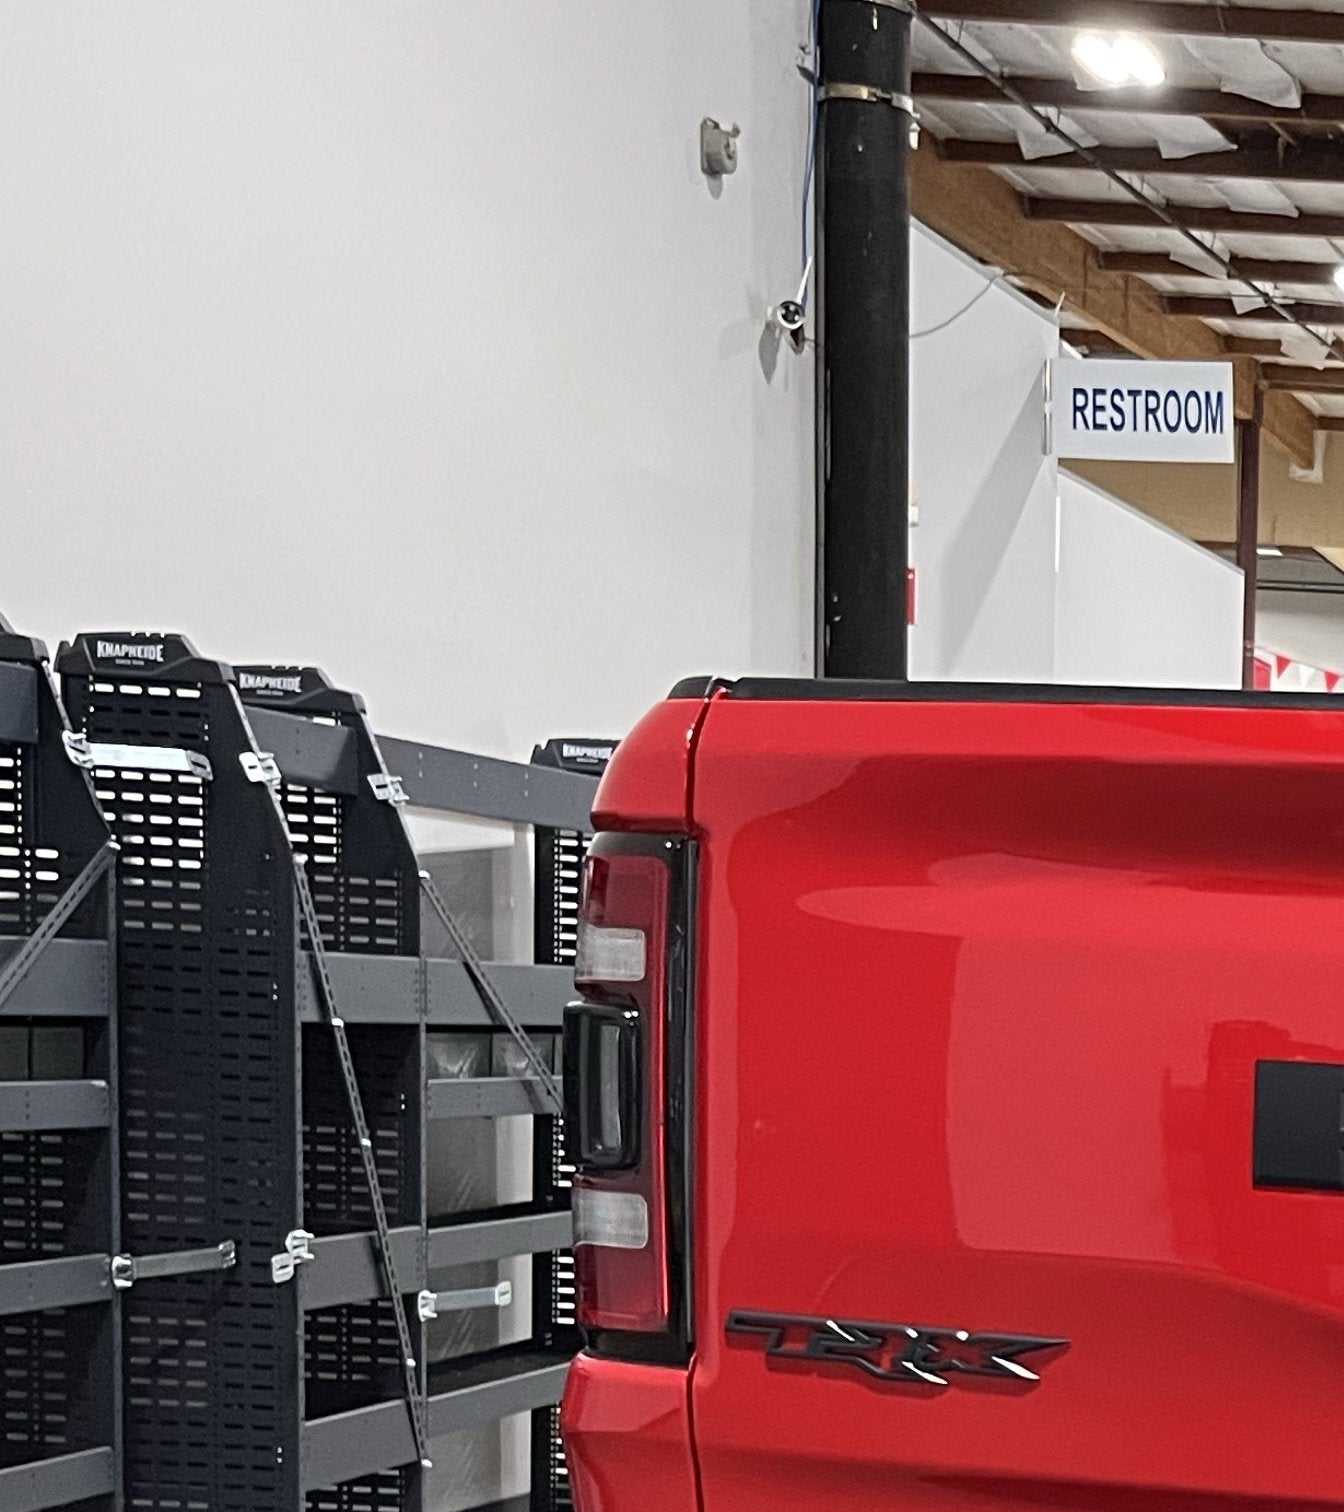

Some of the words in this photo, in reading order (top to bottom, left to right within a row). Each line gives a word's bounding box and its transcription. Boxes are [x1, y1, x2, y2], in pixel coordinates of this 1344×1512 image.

[1073, 387, 1224, 434] RESTROOM
[97, 640, 164, 662] KNAPHEIDE
[725, 1307, 1072, 1386] TRX
